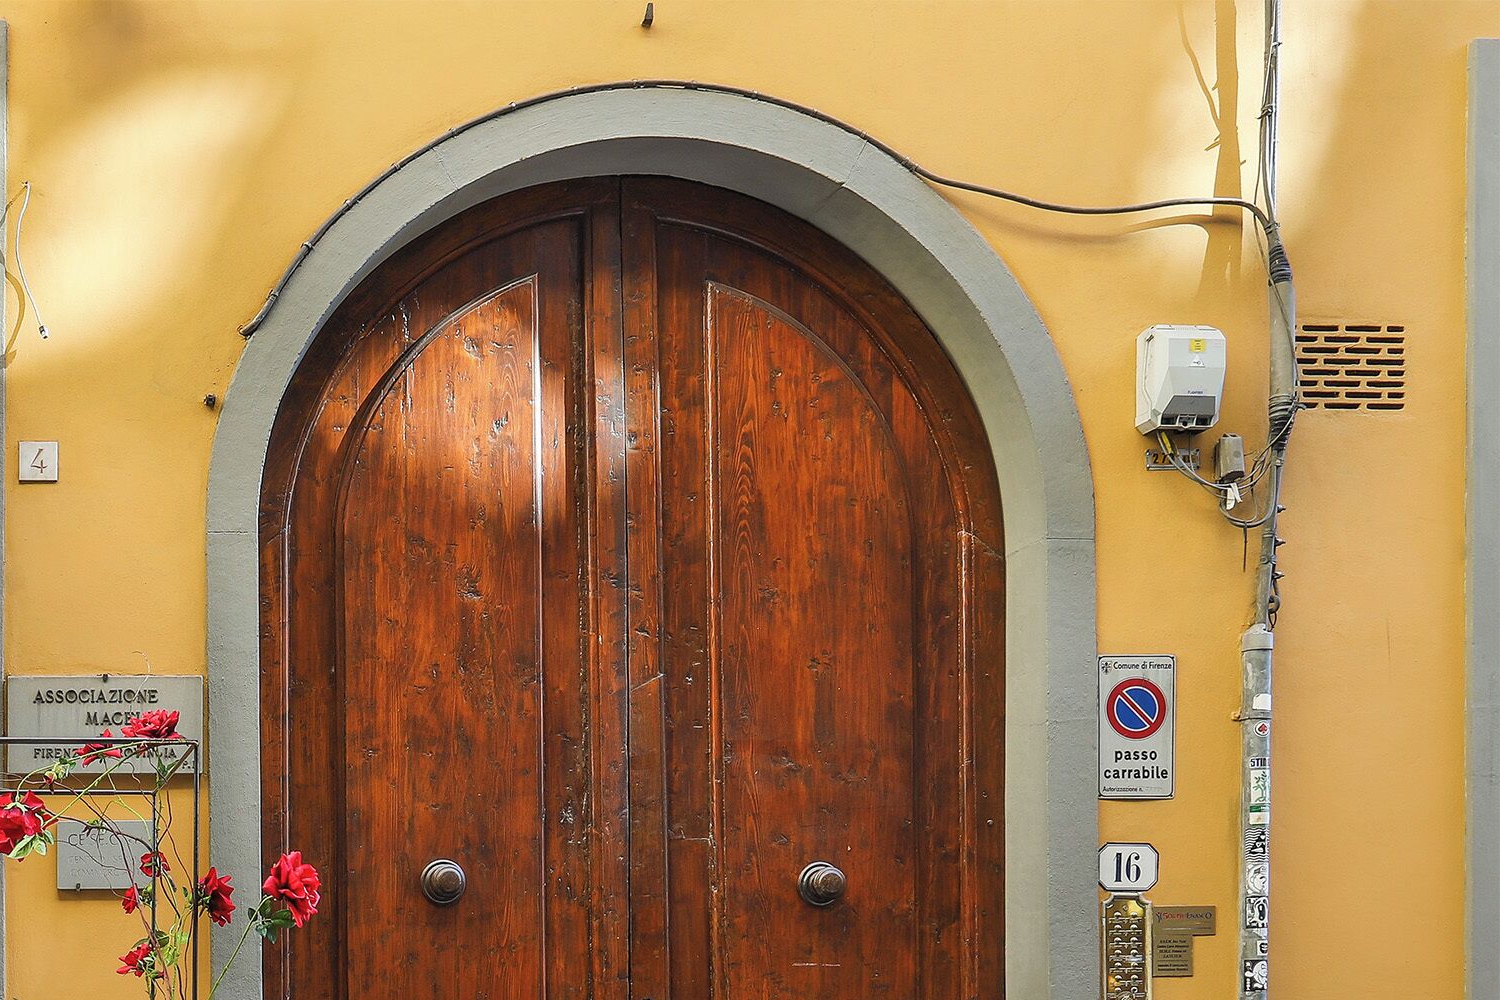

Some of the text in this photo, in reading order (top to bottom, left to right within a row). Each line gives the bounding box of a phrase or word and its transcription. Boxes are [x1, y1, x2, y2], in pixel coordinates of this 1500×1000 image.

[30, 448, 49, 474] 4
[1113, 661, 1172, 670] Comune di Firenze
[33, 689, 160, 704] ASSOCIAZIONE
[1114, 750, 1158, 763] passo
[1103, 765, 1169, 779] carrabile
[1113, 851, 1142, 883] 16
